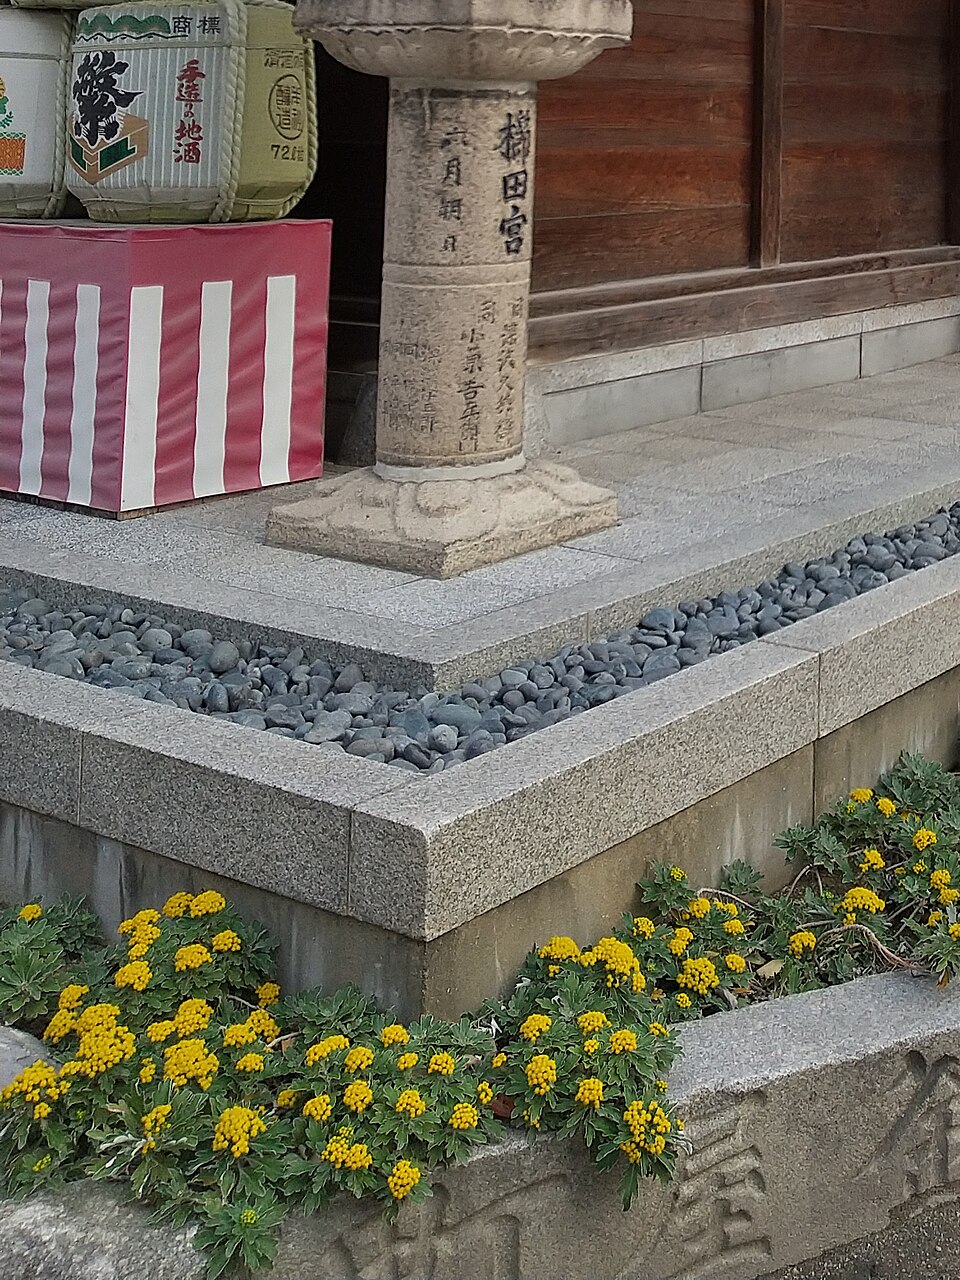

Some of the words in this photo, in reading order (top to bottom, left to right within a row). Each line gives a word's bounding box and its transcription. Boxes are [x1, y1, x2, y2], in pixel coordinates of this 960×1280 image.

[172, 16, 221, 35] 商標
[173, 59, 206, 165] 手造りの地酒
